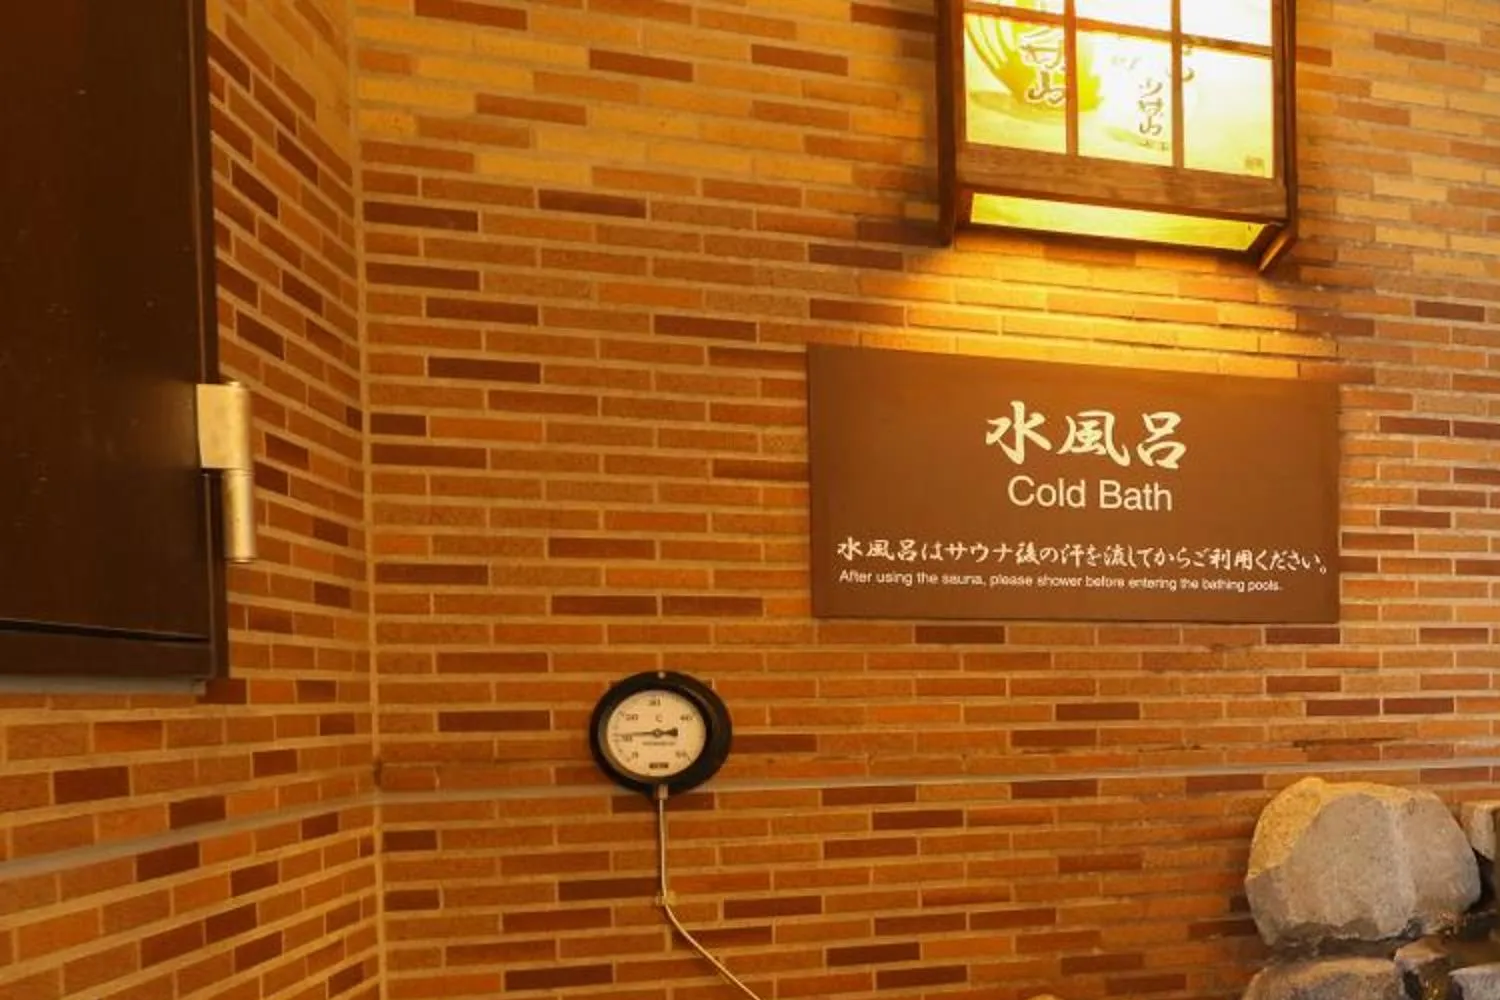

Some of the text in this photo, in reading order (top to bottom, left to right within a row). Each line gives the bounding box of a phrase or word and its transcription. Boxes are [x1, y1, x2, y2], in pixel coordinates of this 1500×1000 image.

[985, 400, 1187, 470] 水風呂
[1007, 475, 1173, 511] Cold Bath
[837, 536, 1328, 574] 水風呂はサウナ後の汗を流してからご利用ください。
[839, 569, 1283, 593] After using the sauna, please shower before entering the bathing pools.
